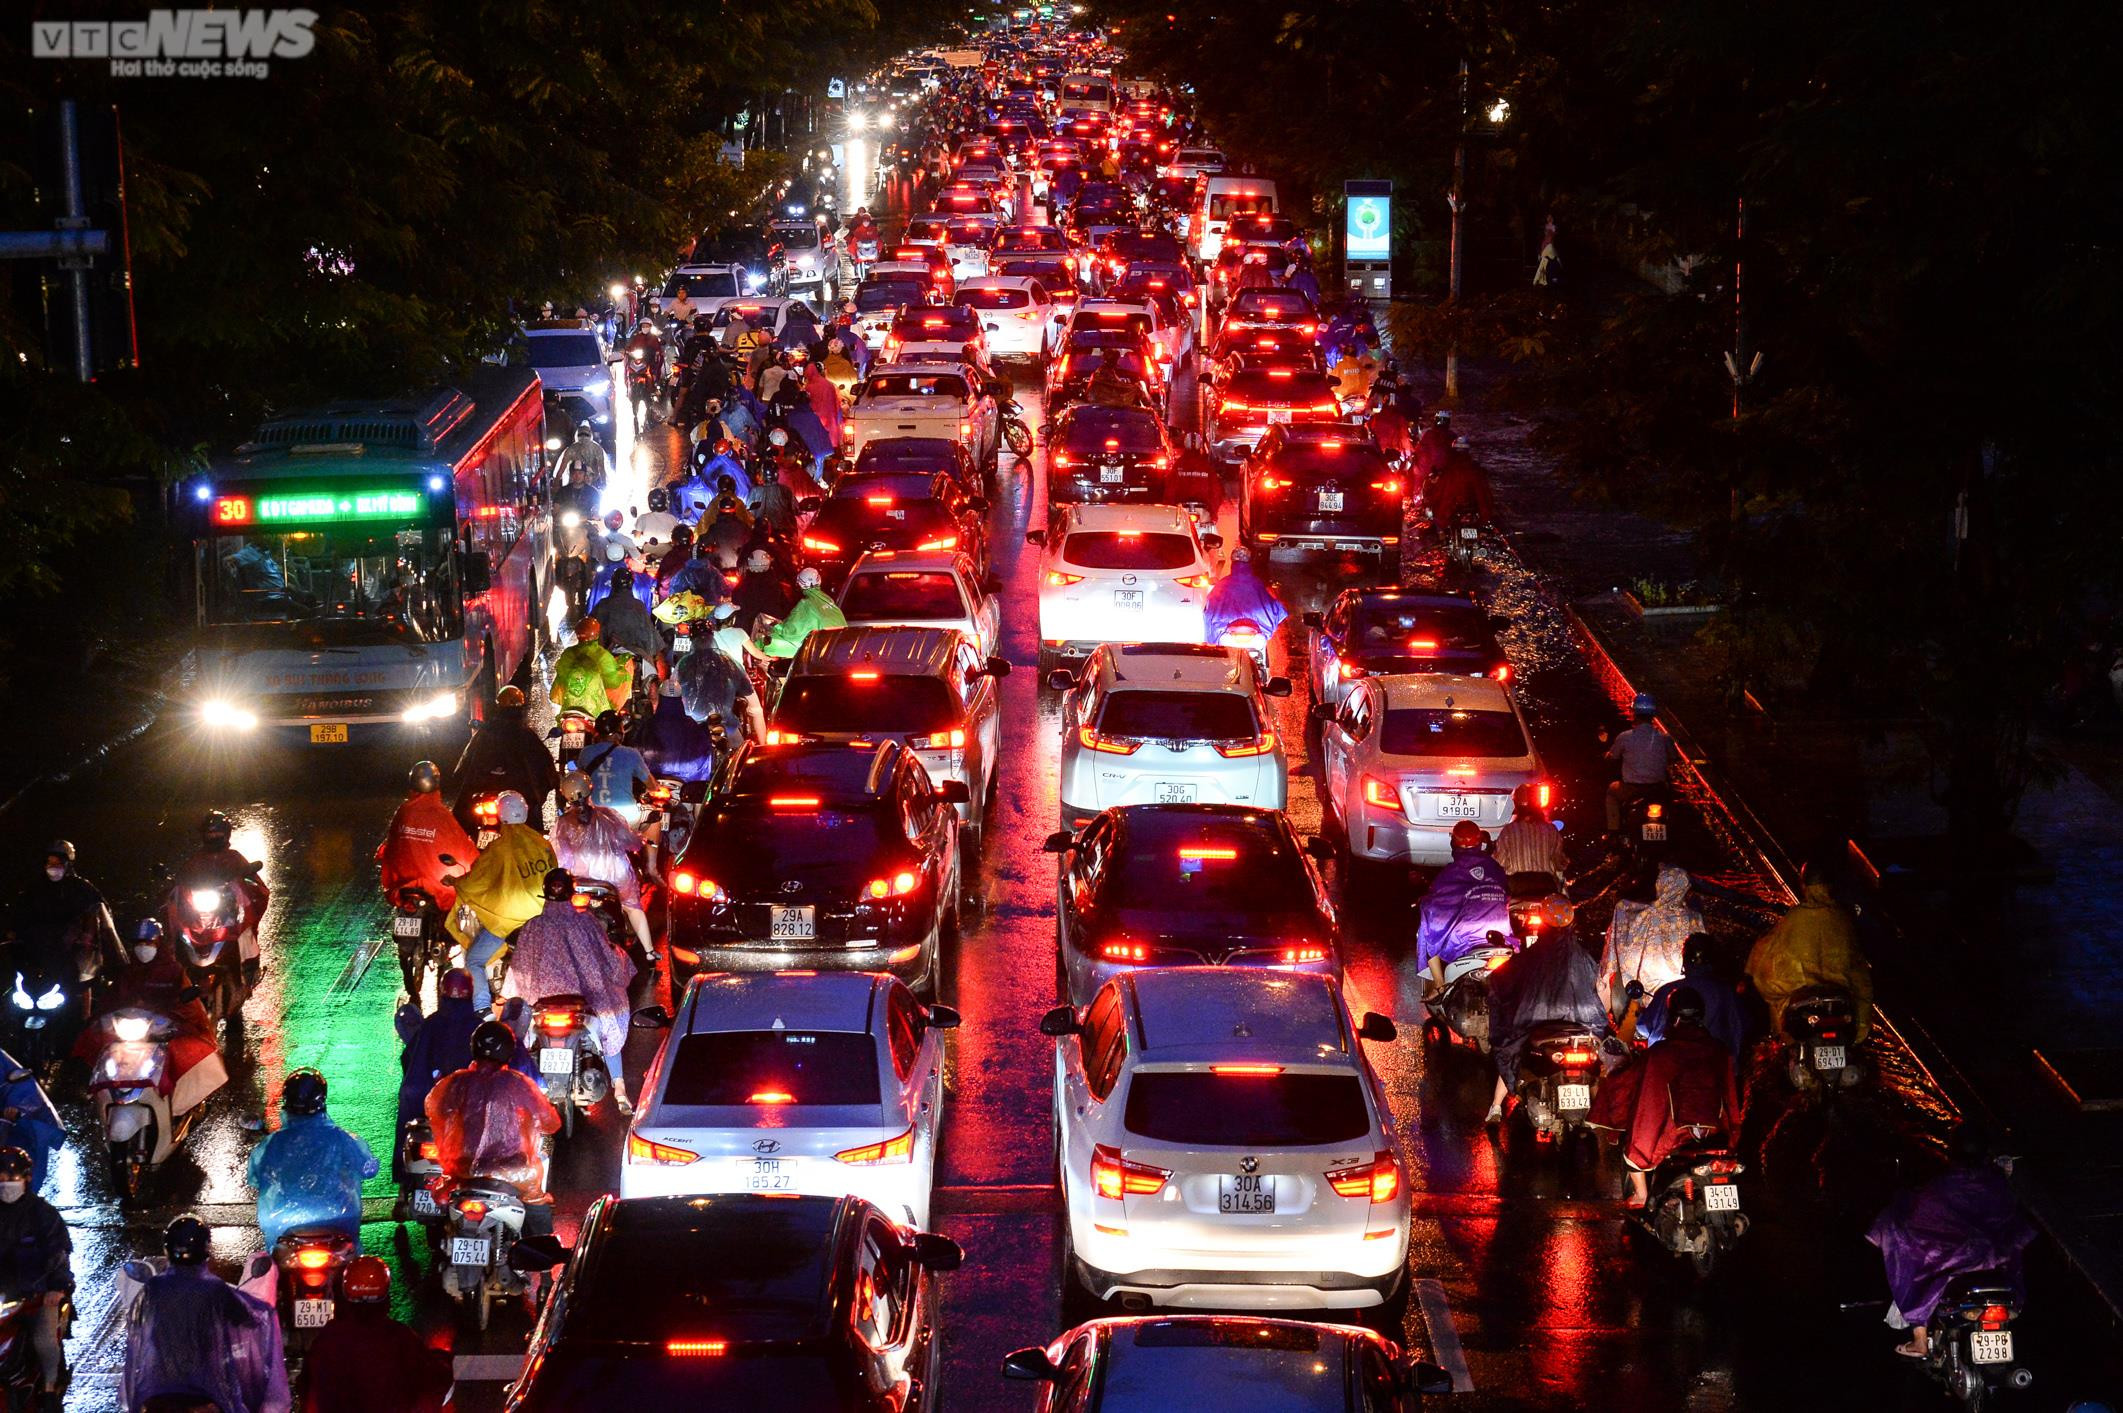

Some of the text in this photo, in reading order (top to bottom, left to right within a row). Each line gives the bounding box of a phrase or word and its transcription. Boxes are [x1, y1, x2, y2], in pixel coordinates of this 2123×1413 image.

[219, 500, 246, 521] 30
[1121, 592, 1136, 601] 30F
[321, 725, 336, 733] 29B
[316, 733, 344, 742] 197.10
[1167, 785, 1186, 795] 30G
[1159, 794, 1192, 803] 52040
[1450, 797, 1467, 806] 37A
[782, 909, 804, 922] 29A
[773, 923, 812, 936] 828.12
[1817, 1057, 1844, 1068] 694.17
[755, 1161, 779, 1173] 30H
[1331, 1157, 1360, 1166] X3
[745, 1175, 790, 1188] 185.27
[1234, 1176, 1261, 1192] 30A
[1710, 1187, 1732, 1197] 34-C1
[1222, 1194, 1272, 1210] 314.56
[1708, 1196, 1738, 1209] 431.49
[458, 1240, 484, 1251] 29-C1
[453, 1251, 487, 1264] 075.44
[296, 1313, 331, 1326] 650.47
[1979, 1347, 2007, 1360] 2298
